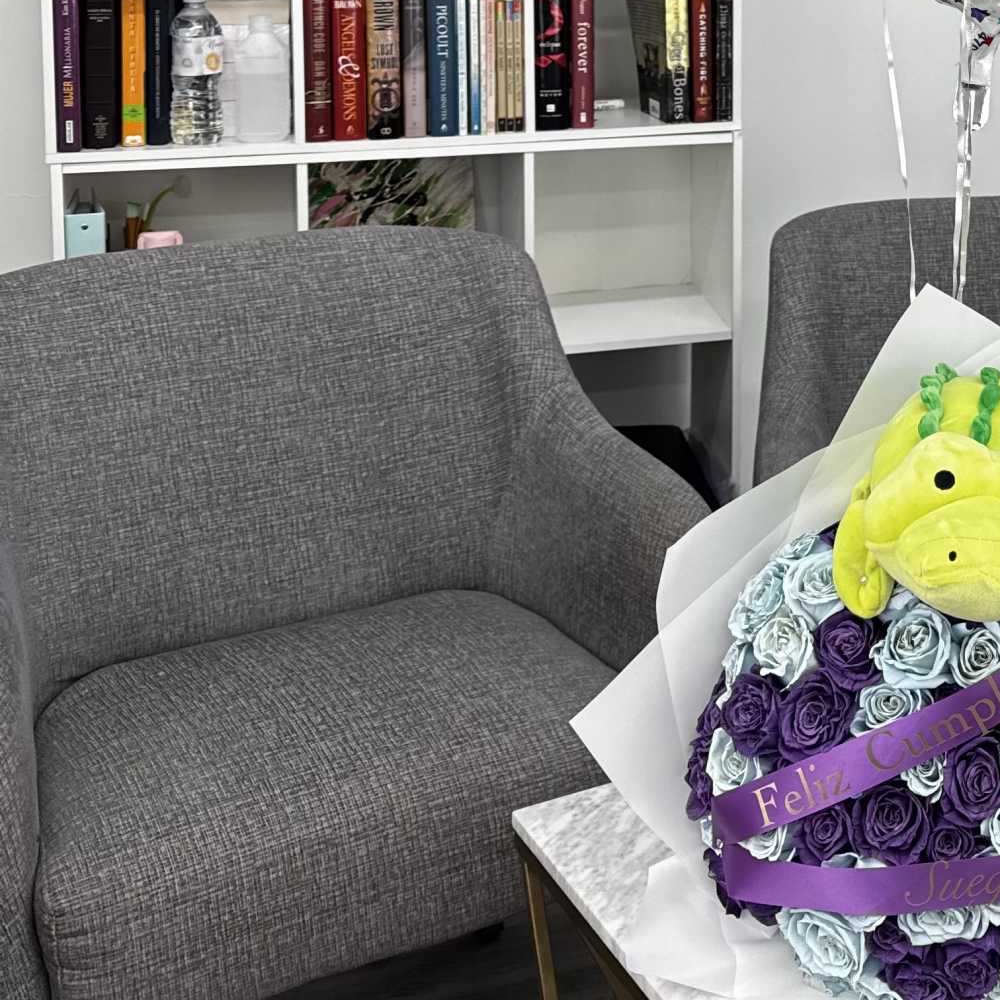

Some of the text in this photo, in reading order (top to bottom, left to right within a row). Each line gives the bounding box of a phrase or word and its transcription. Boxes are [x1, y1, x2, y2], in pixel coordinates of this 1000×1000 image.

[313, 33, 324, 53] CODE
[435, 5, 449, 58] PICOULT
[576, 21, 591, 74] forever
[699, 14, 708, 81] CATCHING FIRE
[62, 27, 74, 108] MUJER MILLONARIA
[338, 14, 360, 121] ANGELS & DEMONS
[673, 78, 687, 120] Bones
[752, 765, 851, 829] Feliz
